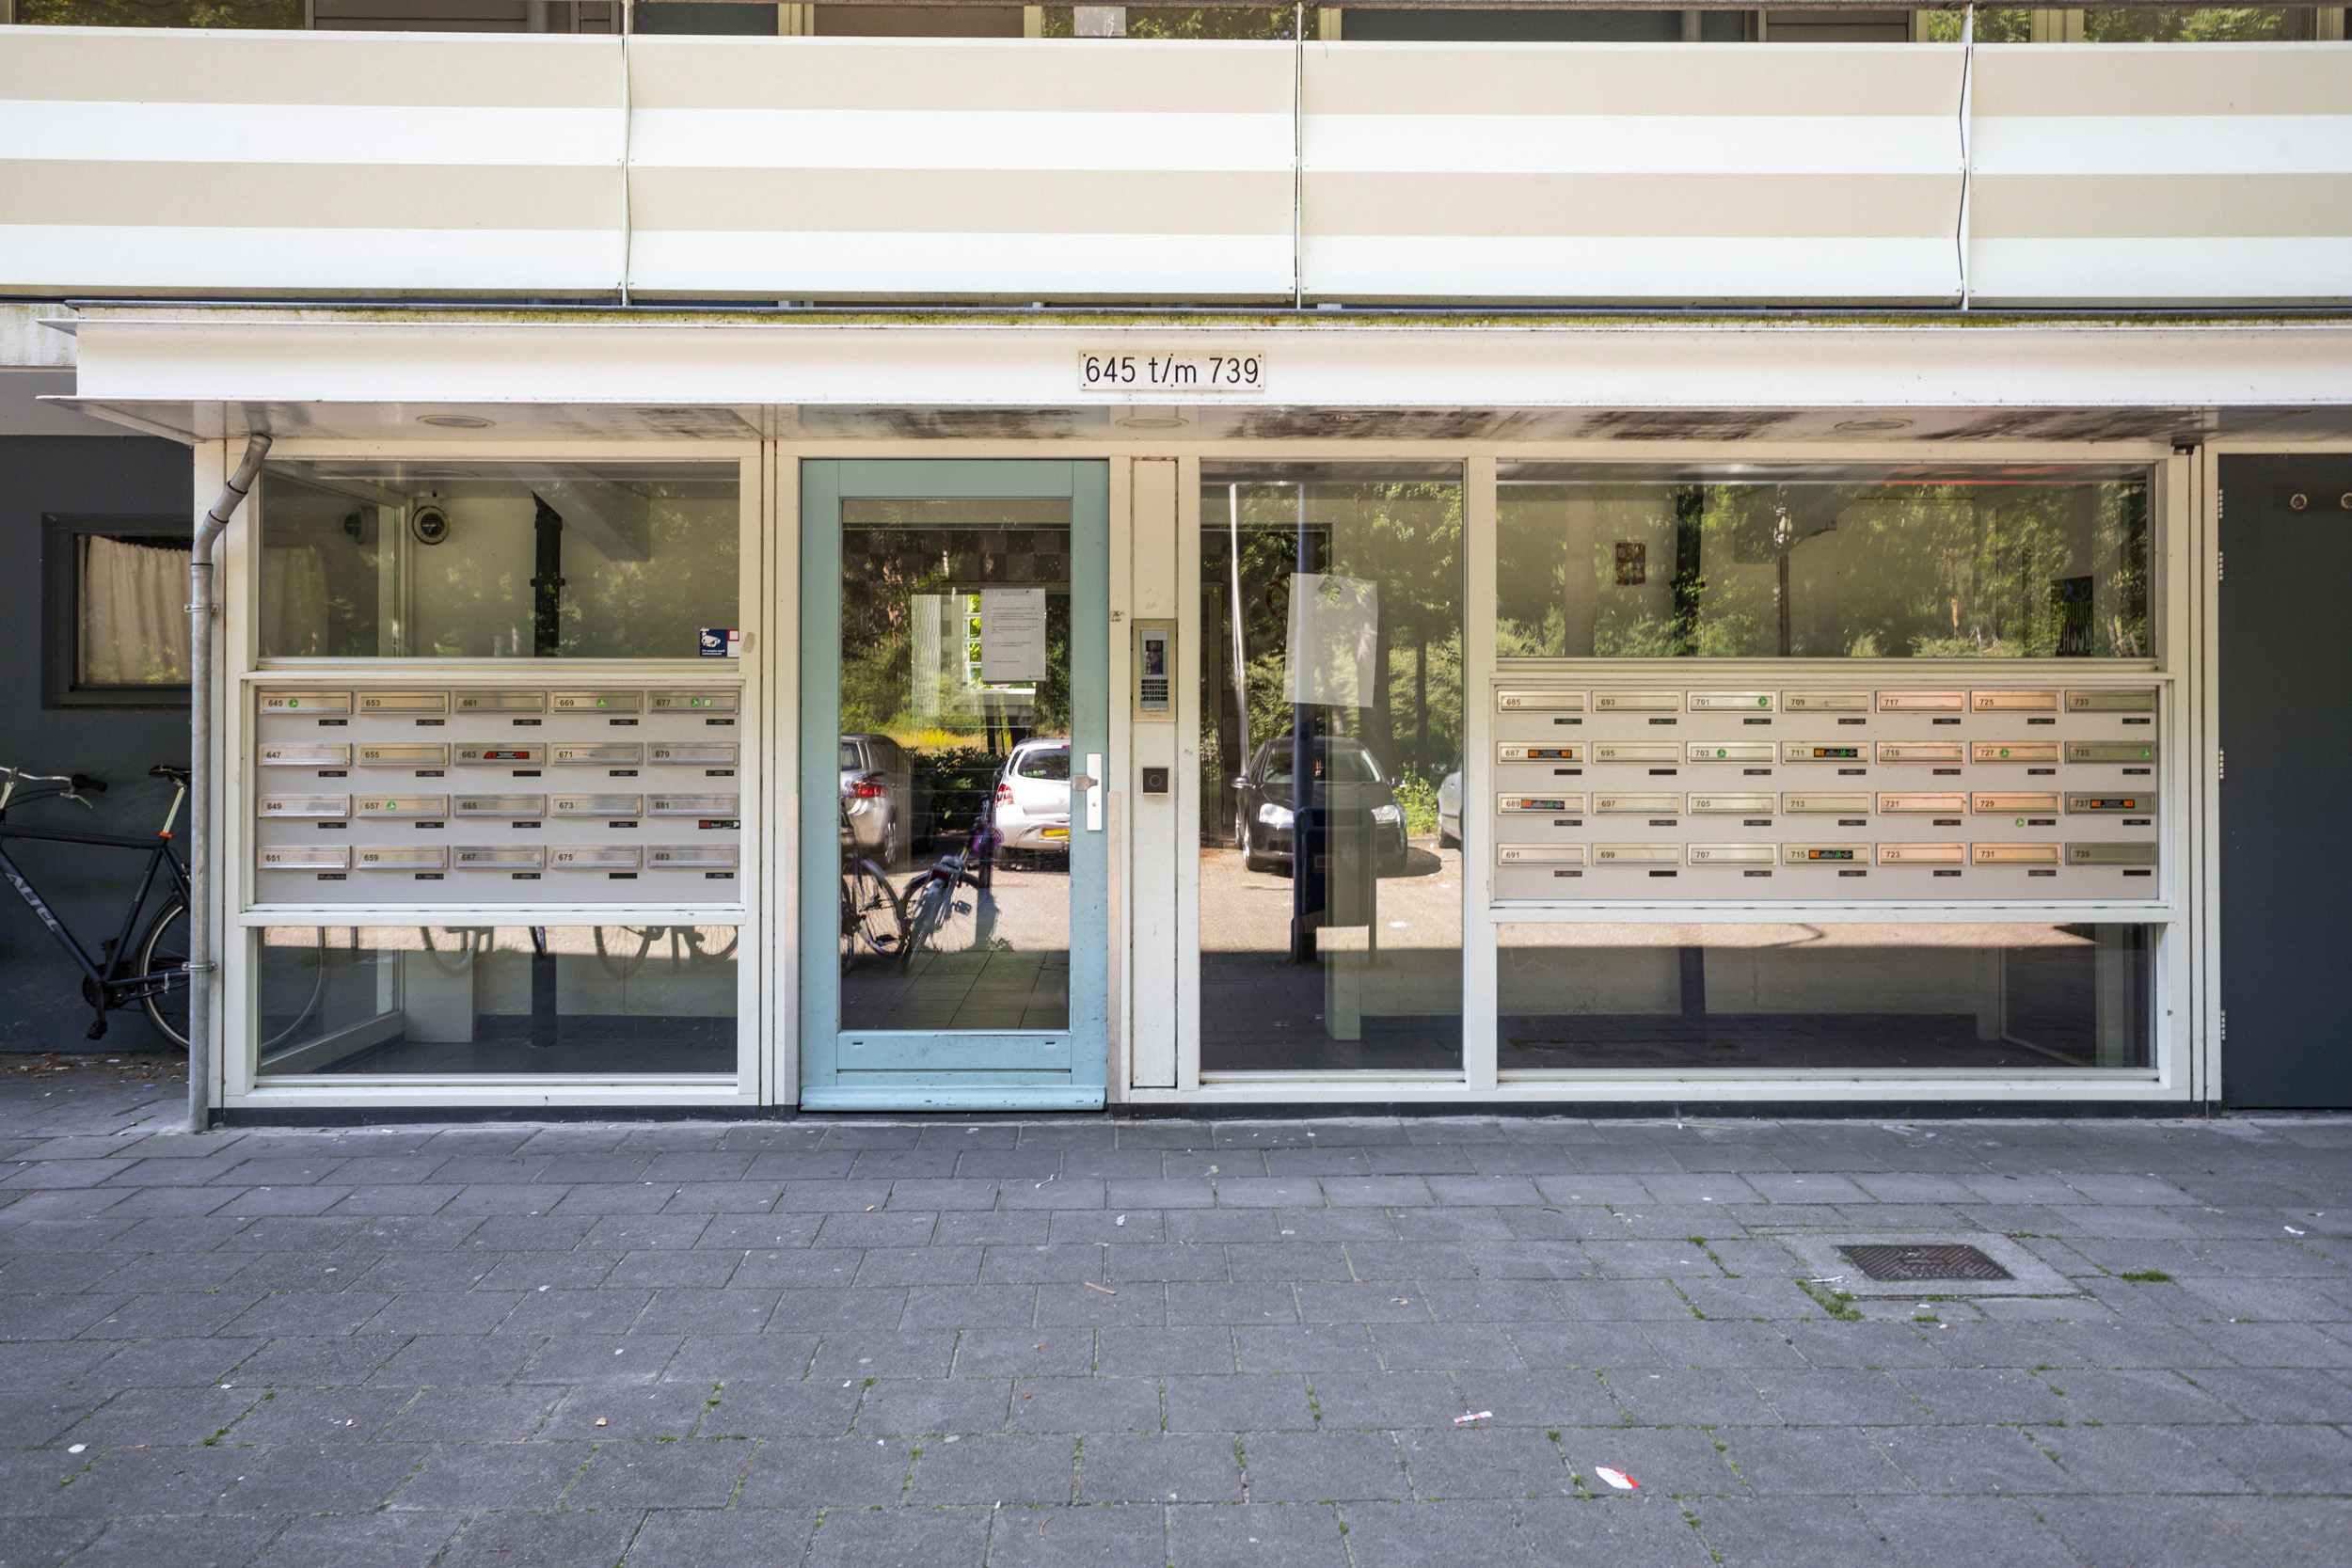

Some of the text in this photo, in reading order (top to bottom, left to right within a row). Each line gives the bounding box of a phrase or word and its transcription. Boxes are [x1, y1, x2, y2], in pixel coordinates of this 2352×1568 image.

[1085, 356, 1259, 384] 645 t/m 739
